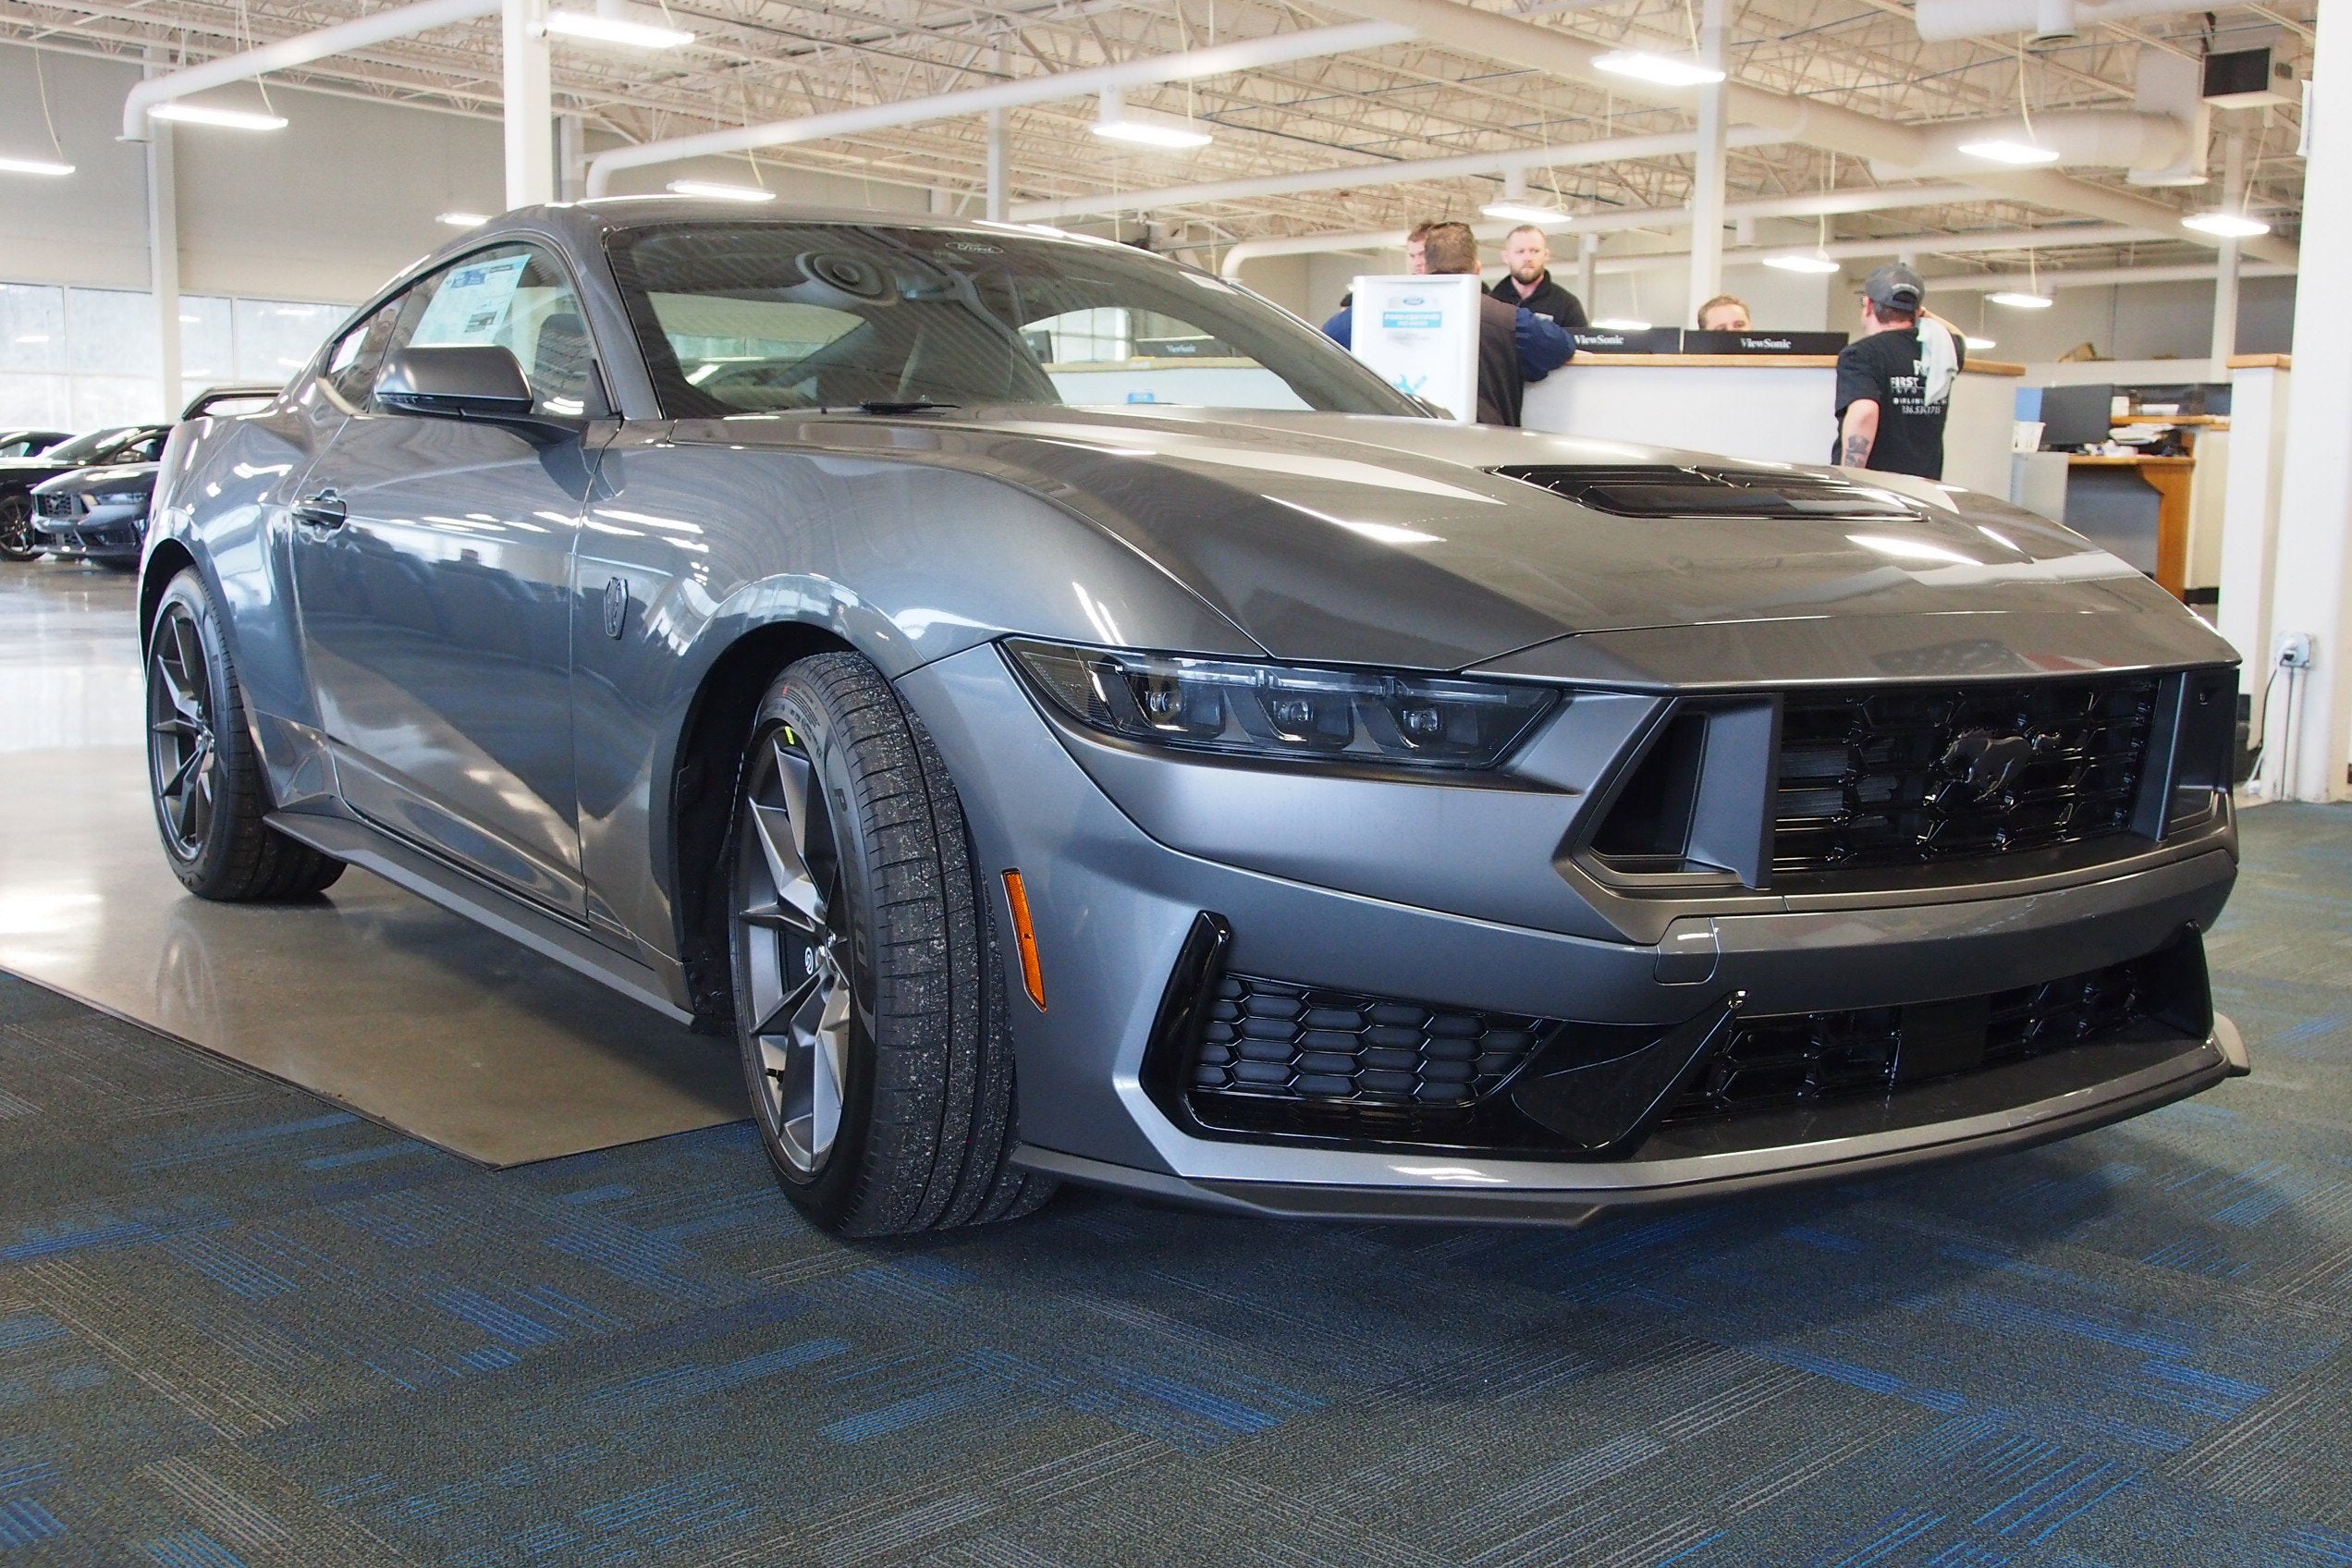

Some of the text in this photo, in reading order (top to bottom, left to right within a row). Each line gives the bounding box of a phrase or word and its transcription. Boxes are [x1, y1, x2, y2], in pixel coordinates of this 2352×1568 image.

[1574, 334, 1624, 345] ViewSonic
[1740, 337, 1792, 349] ViewSonic
[1890, 377, 1919, 386] FIRST
